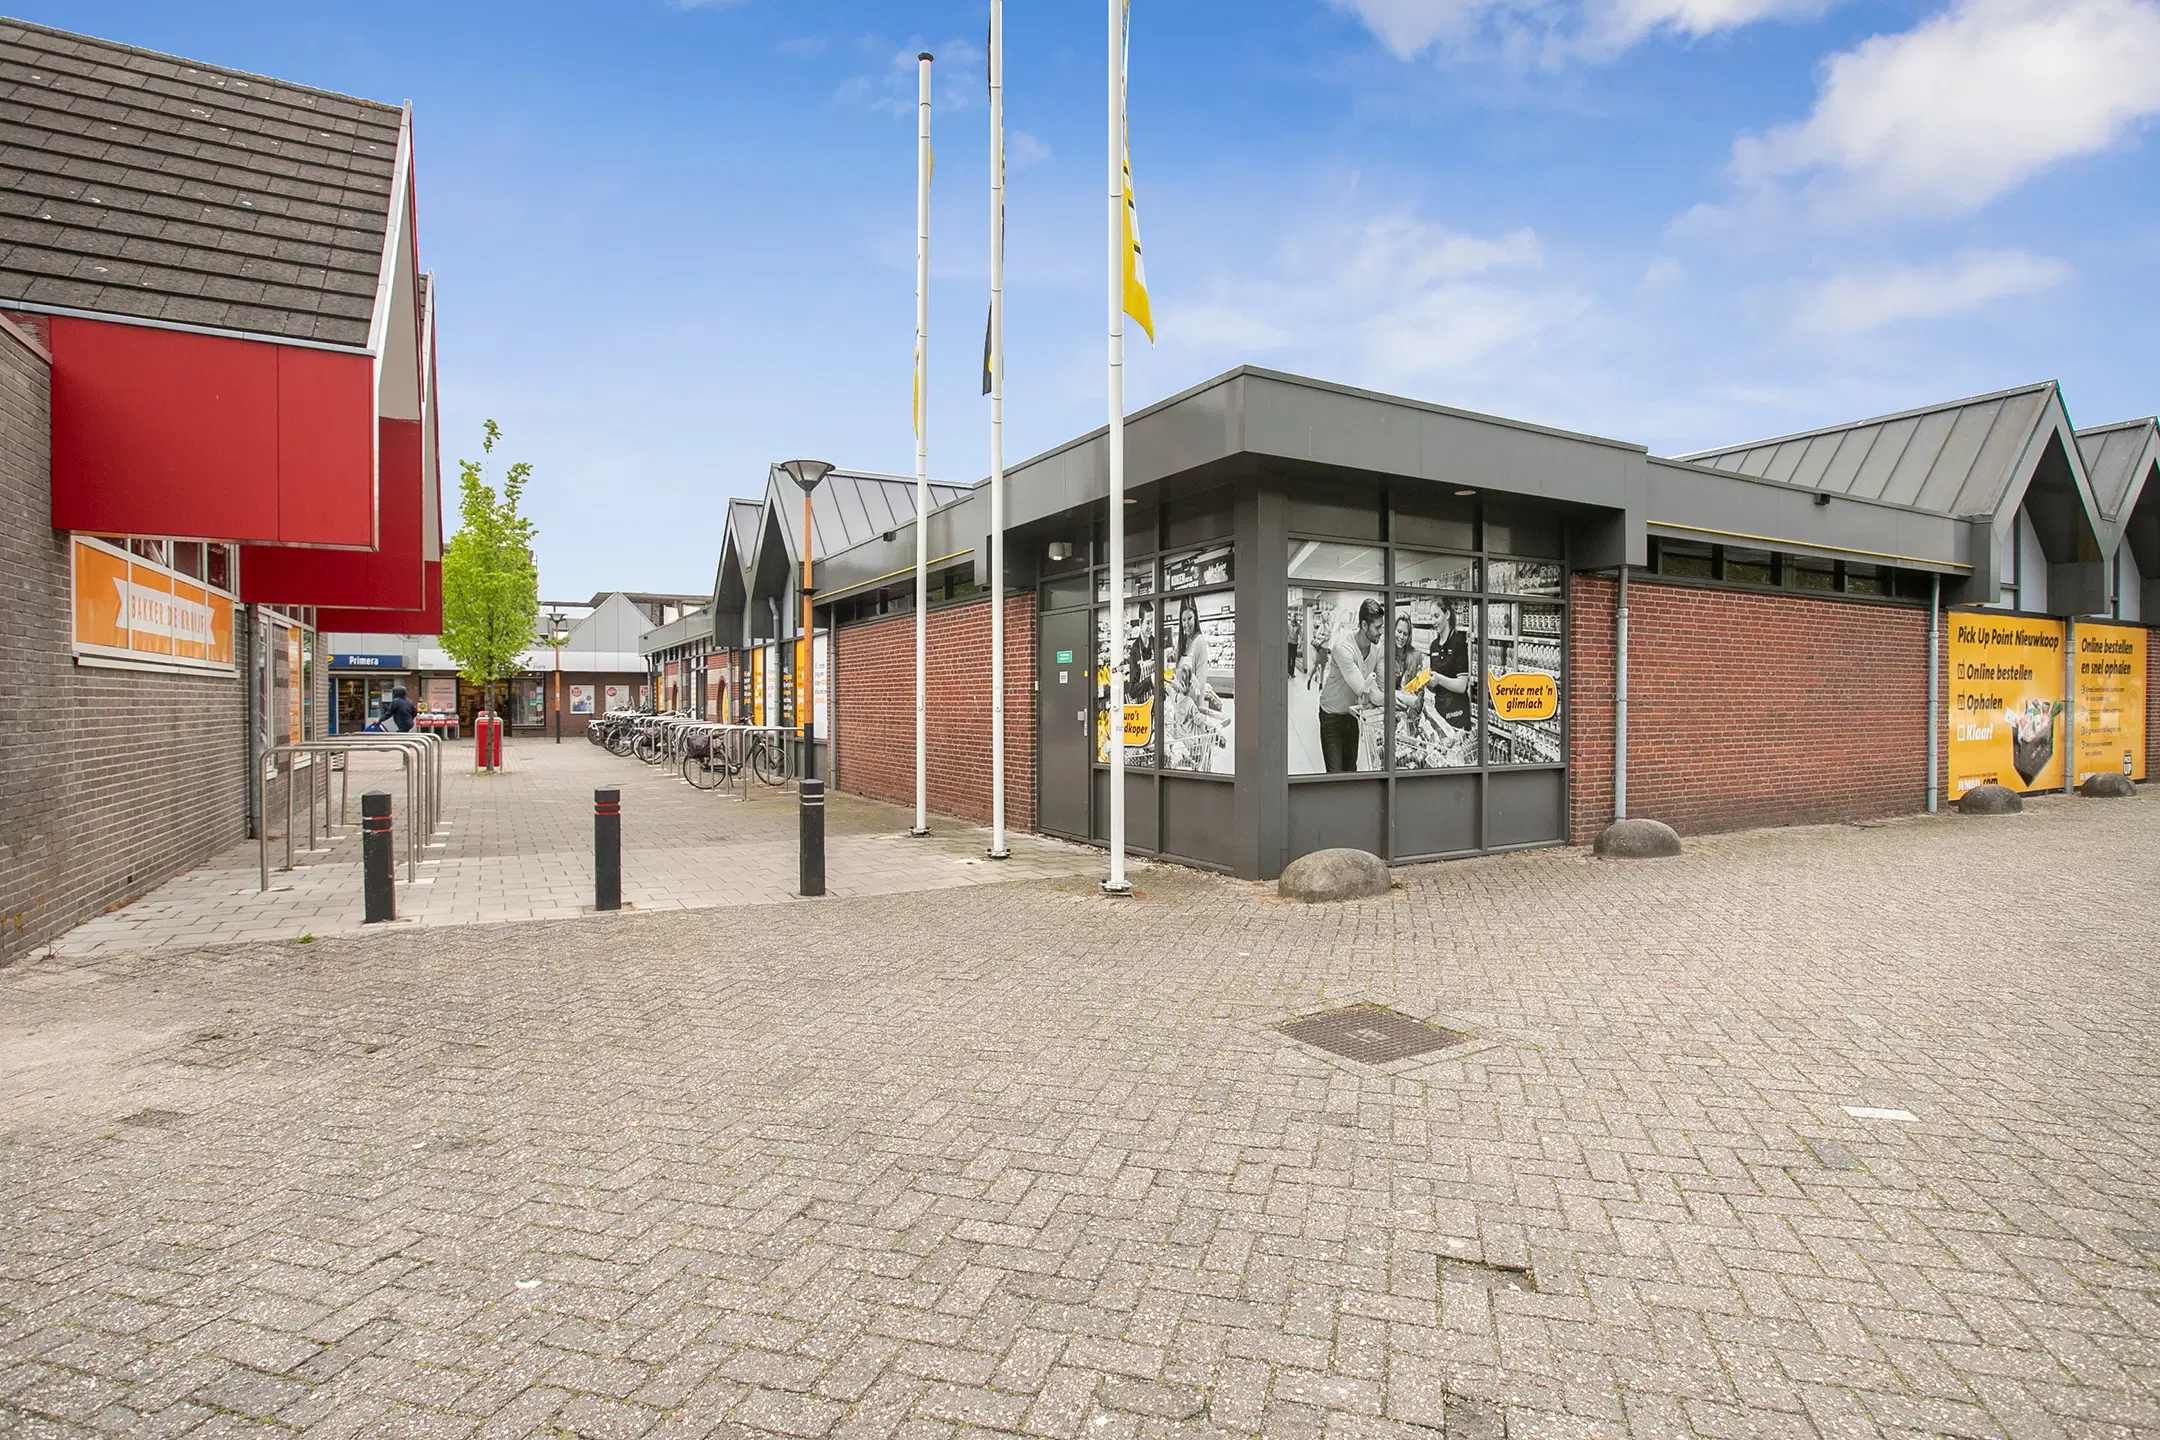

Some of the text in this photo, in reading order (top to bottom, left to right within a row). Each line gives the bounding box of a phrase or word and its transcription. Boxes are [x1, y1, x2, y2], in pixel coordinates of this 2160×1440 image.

[131, 594, 163, 625] BAKKER
[168, 605, 177, 628] DE
[1958, 626, 2059, 652] Pick Up Point Nieuwkoop
[2082, 637, 2133, 654] Online bestellen
[349, 655, 379, 665] Primera
[1967, 663, 2033, 680] Online bestellen
[2081, 659, 2131, 679] en snel ophalen
[1496, 684, 1553, 696] Service met 'n
[1506, 697, 1543, 712] glimlach
[1967, 693, 2003, 715] Ophalen
[1123, 710, 1140, 720] uro's
[1966, 722, 1993, 740] Klaar!
